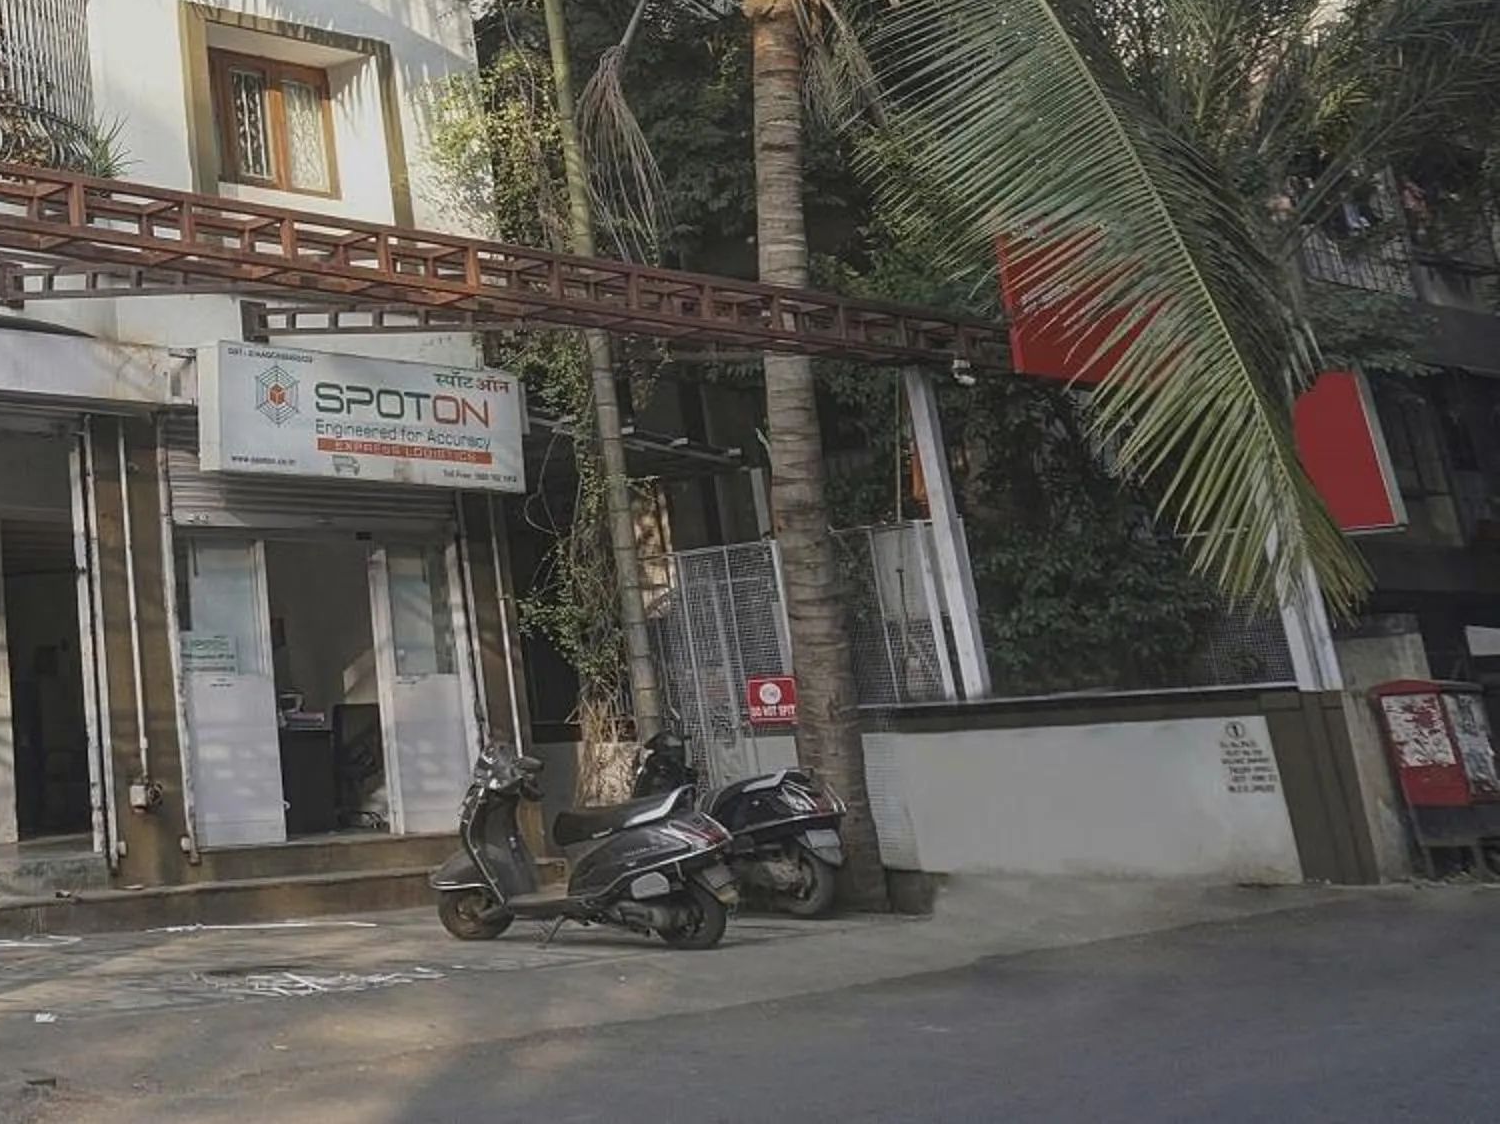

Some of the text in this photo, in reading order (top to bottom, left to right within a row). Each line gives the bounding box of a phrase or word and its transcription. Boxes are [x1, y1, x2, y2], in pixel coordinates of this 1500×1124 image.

[315, 382, 489, 428] SPOTON
[316, 419, 491, 453] Engineered for Accuracy
